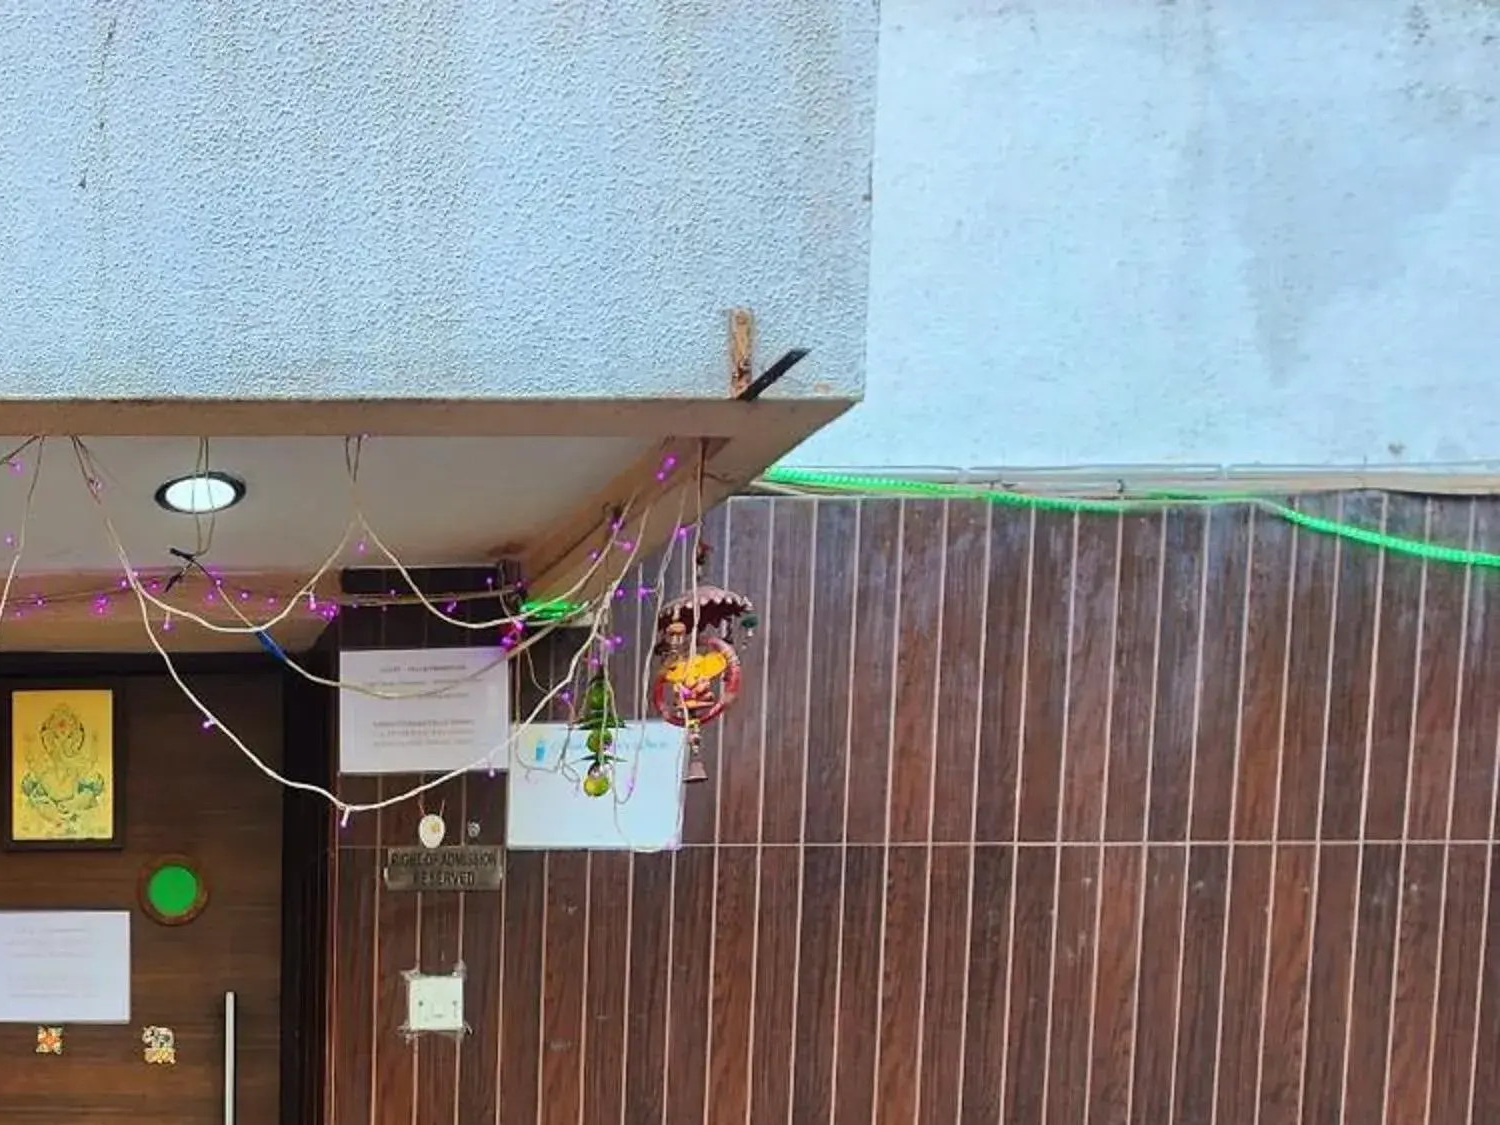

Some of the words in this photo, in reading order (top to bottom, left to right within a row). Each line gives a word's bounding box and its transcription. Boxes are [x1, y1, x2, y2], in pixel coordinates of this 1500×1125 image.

[392, 850, 422, 866] RIGHT
[423, 851, 439, 866] OF
[442, 850, 498, 867] ADMISSION
